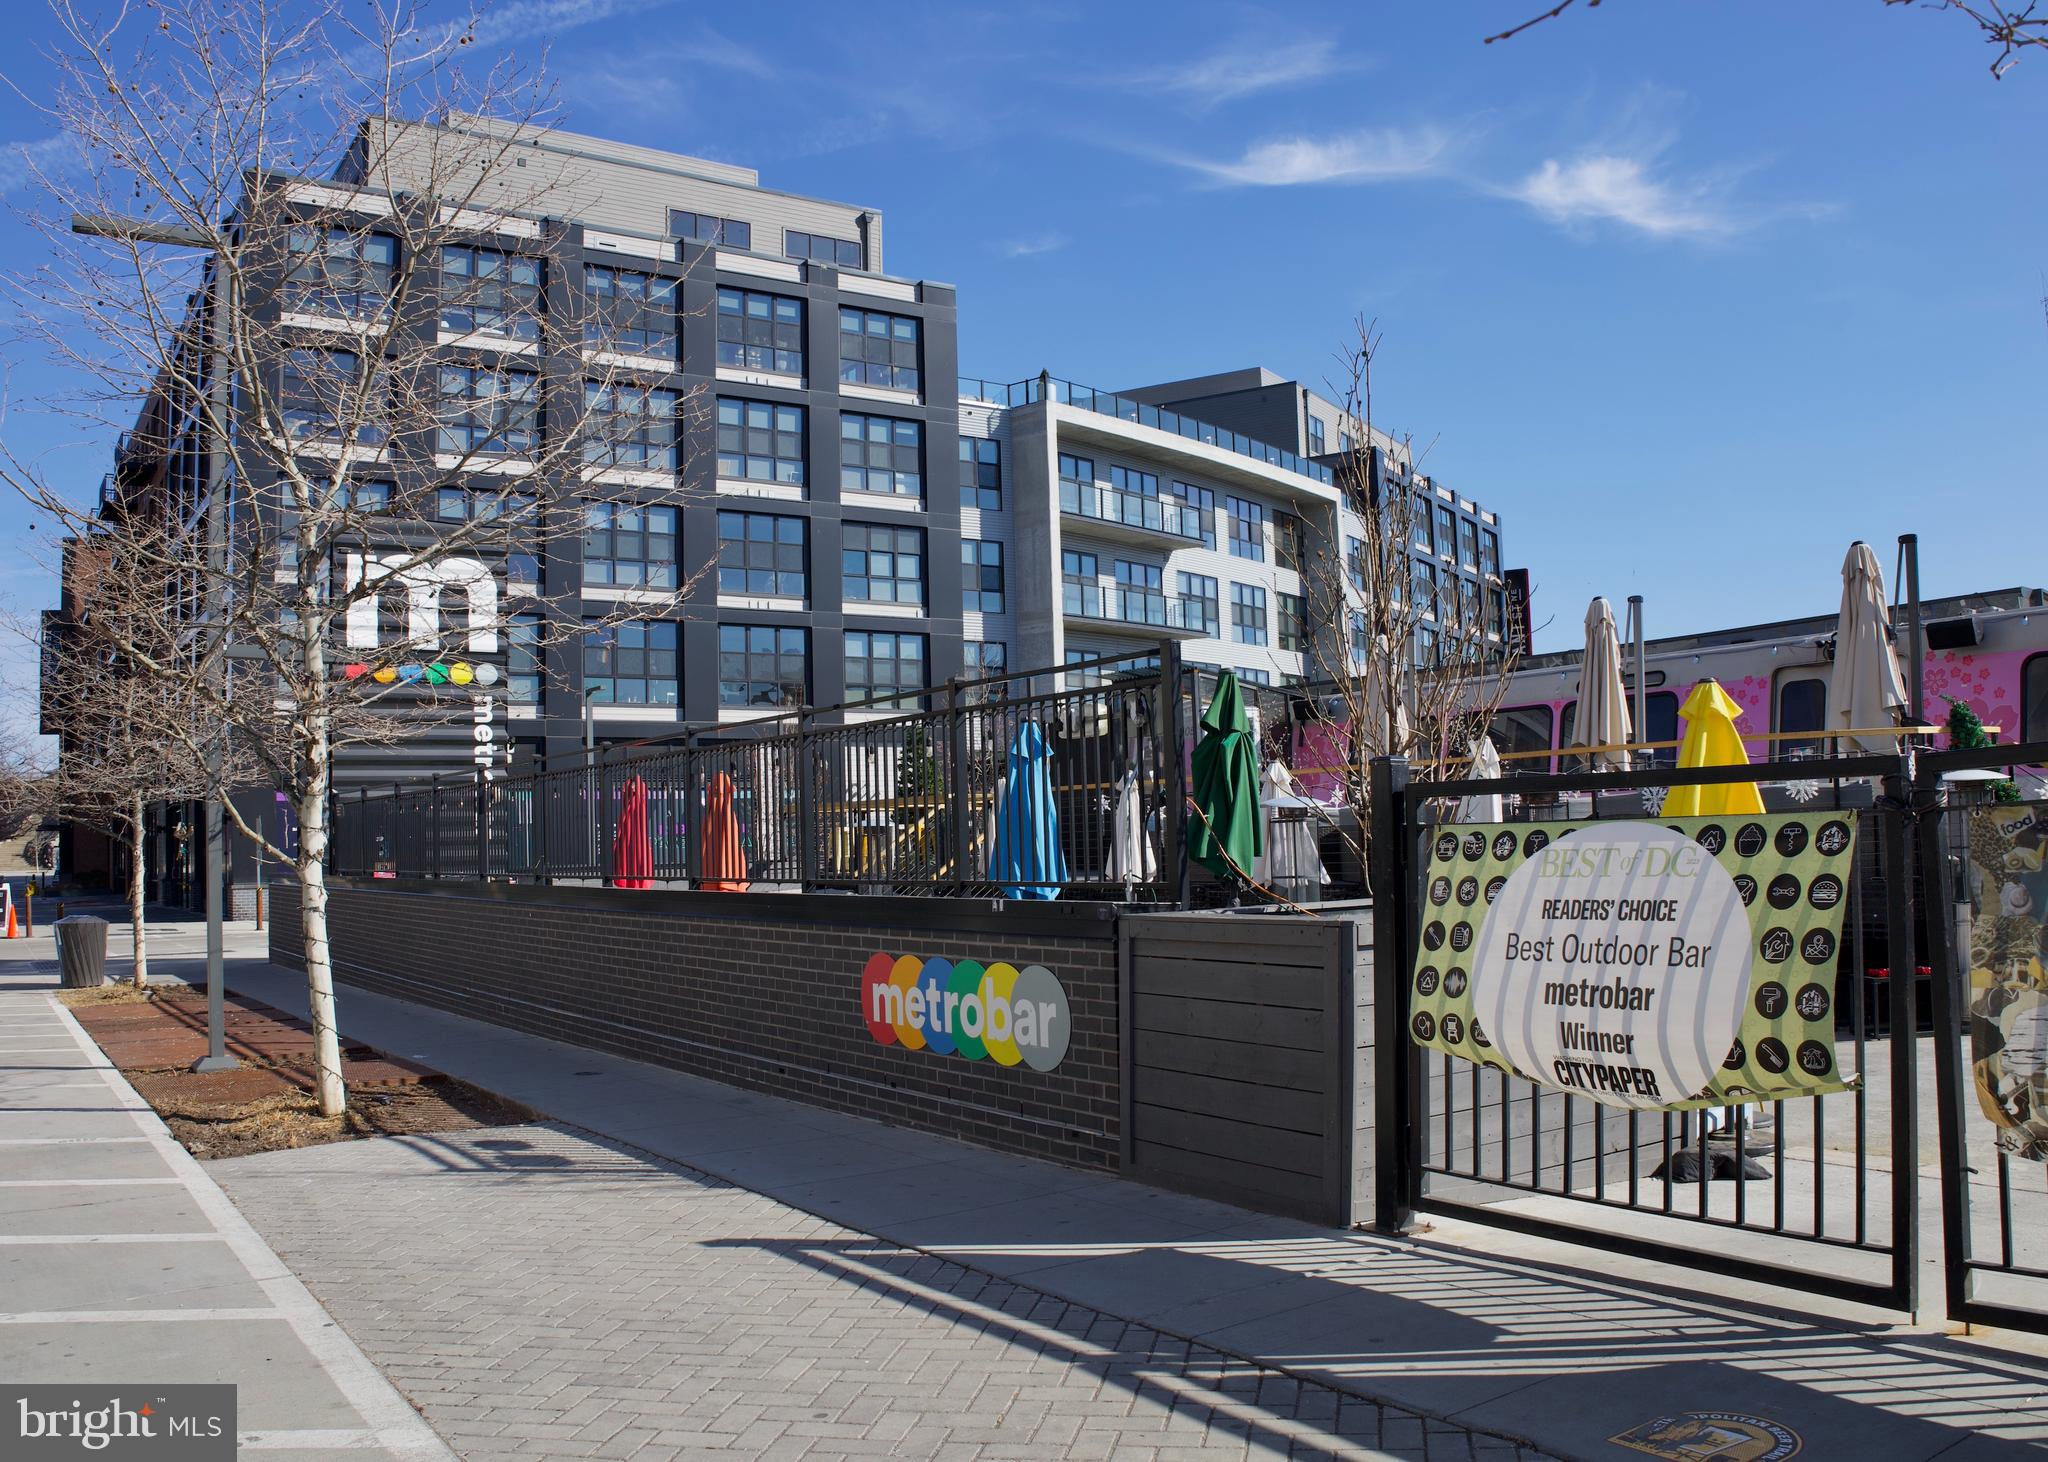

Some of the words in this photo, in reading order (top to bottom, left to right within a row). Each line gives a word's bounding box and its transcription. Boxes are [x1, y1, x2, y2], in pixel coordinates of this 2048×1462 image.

[2001, 813, 2032, 836] food
[1538, 847, 1620, 878] BEST
[1619, 849, 1642, 876] of
[1617, 899, 1678, 921] CHOICE
[1505, 932, 1555, 962] Best
[1562, 933, 1659, 966] Outdoor
[1667, 936, 1711, 968] Bar
[1544, 976, 1655, 1011] metrobar
[872, 977, 1056, 1048] metrobar
[1560, 1021, 1634, 1054] Winner
[1553, 1054, 1594, 1064] WASHINGTON
[1767, 1426, 1794, 1443] BEER
